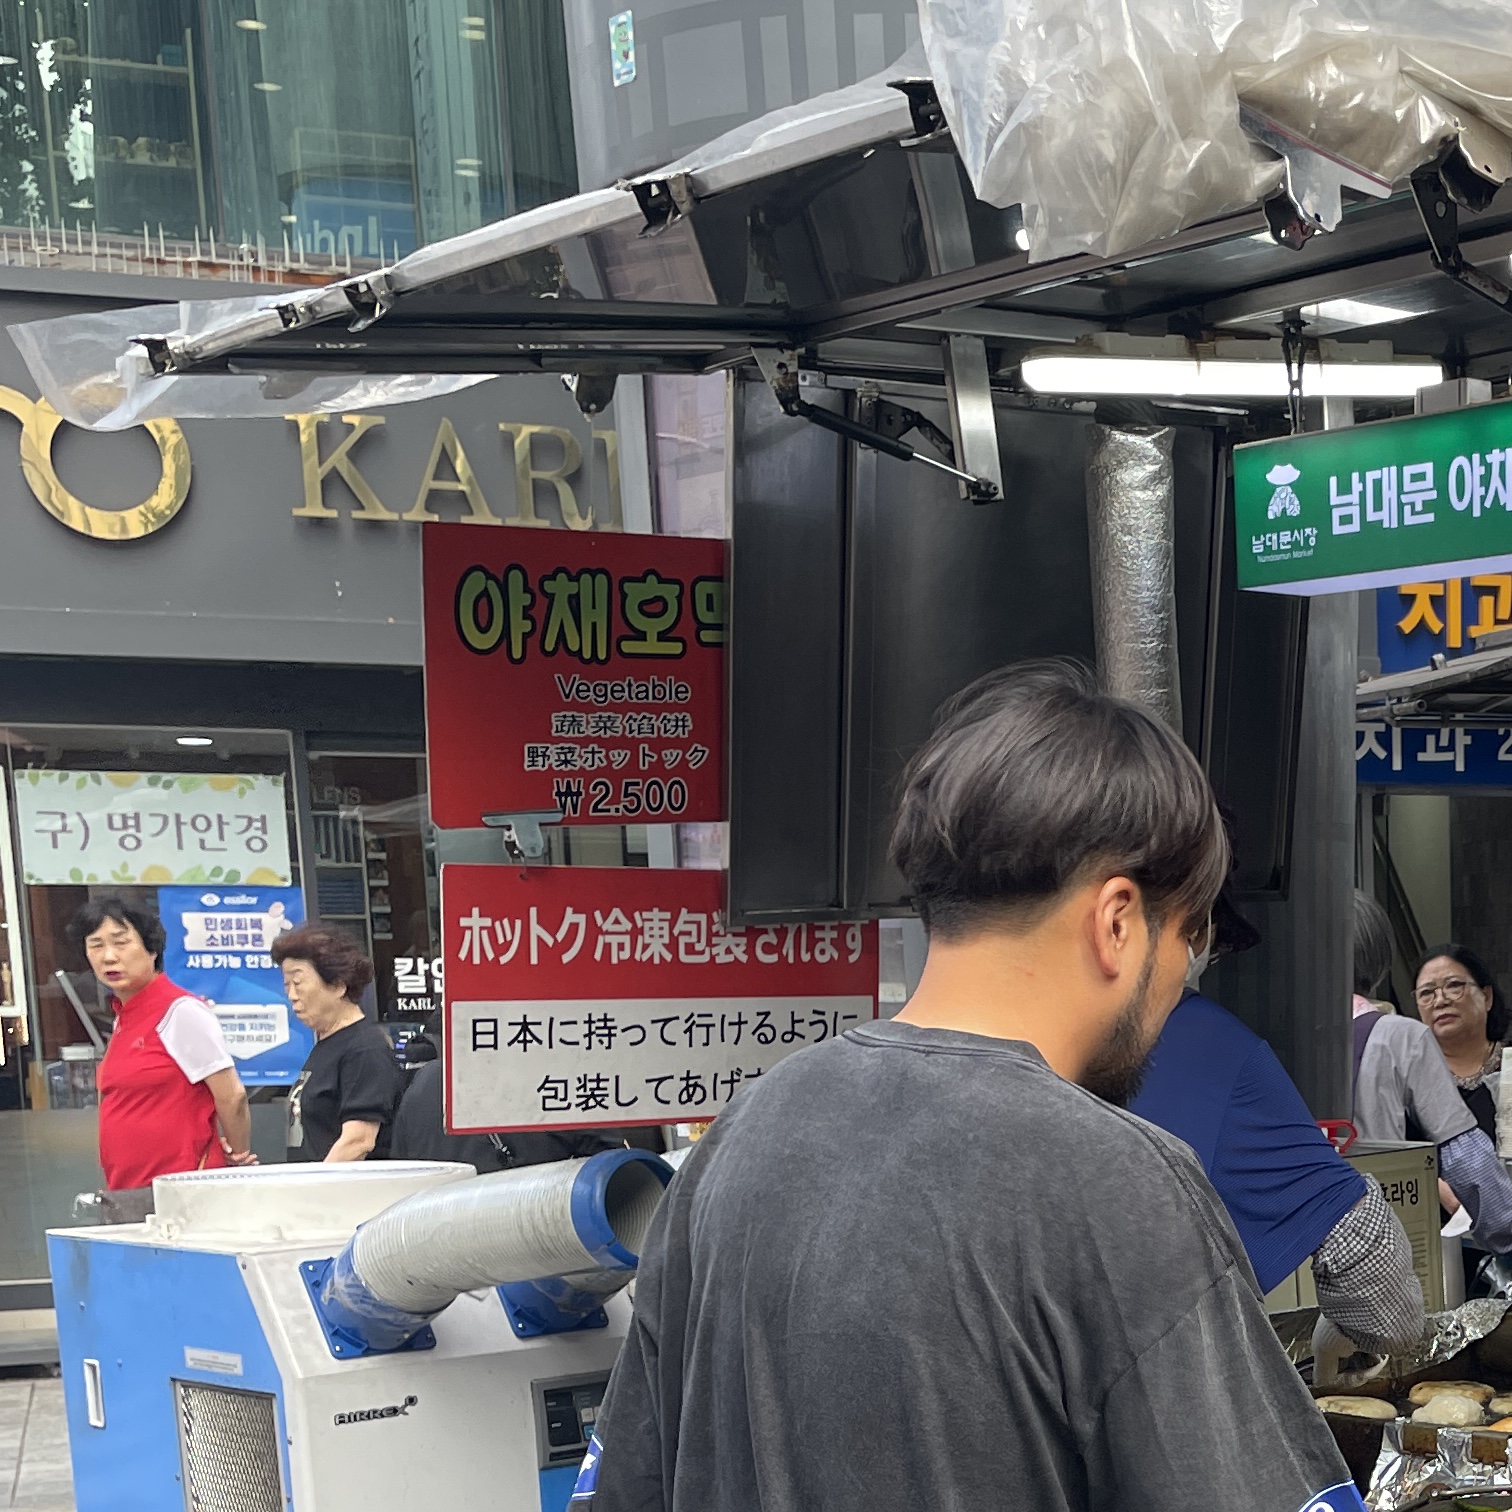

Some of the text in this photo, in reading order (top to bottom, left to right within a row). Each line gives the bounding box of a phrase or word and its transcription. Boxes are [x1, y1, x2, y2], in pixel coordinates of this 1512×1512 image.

[1328, 461, 1439, 535] 남대문
[1252, 527, 1318, 553] 남대문시장
[555, 674, 691, 706] Vegetable
[552, 712, 693, 738] 蔬菜馅饼
[524, 744, 710, 770] 野菜ホットック
[35, 810, 269, 853] 구) 명가안경
[204, 917, 263, 931] 민생회복
[205, 934, 264, 947] 소비쿠폰
[397, 997, 436, 1011] KARL
